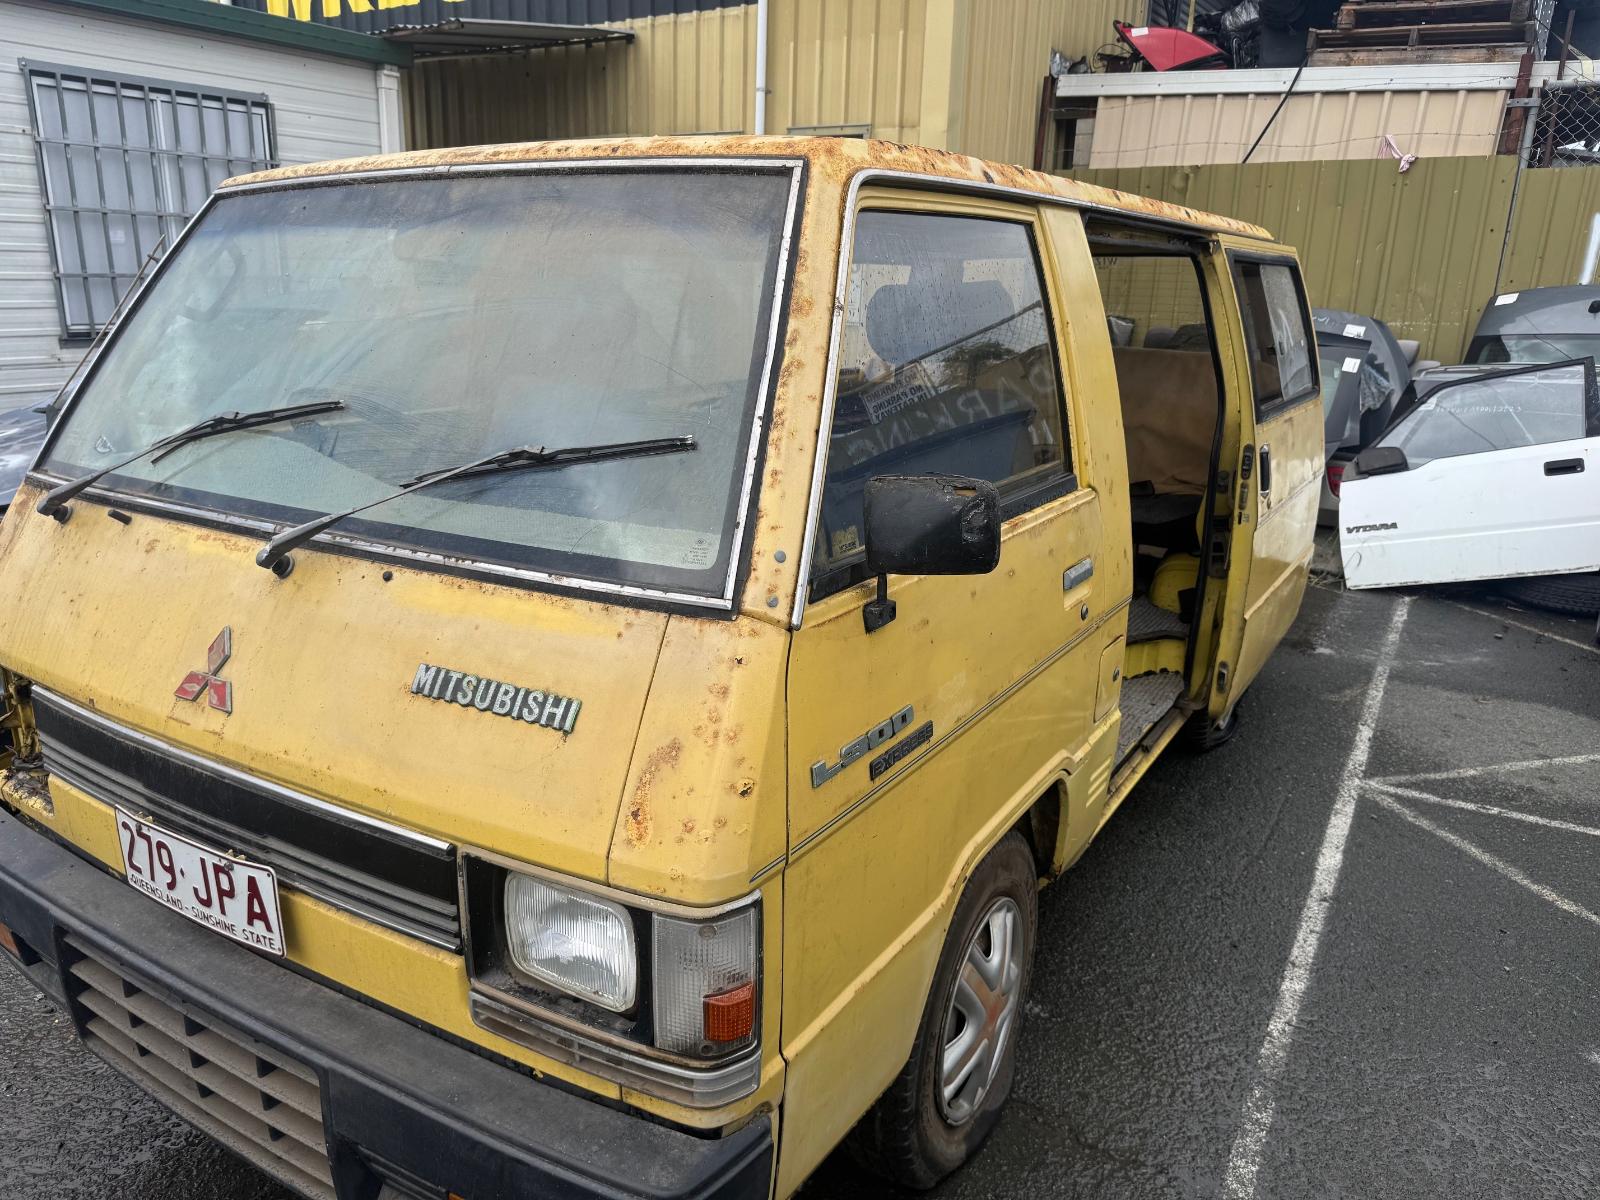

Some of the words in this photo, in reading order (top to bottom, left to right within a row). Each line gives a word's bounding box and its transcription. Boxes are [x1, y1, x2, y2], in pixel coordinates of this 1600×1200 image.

[411, 663, 582, 734] MITSUBISHI
[130, 873, 183, 910] QUEENSLAND
[191, 906, 238, 936] SUNSHINE
[242, 928, 276, 950] STATE
